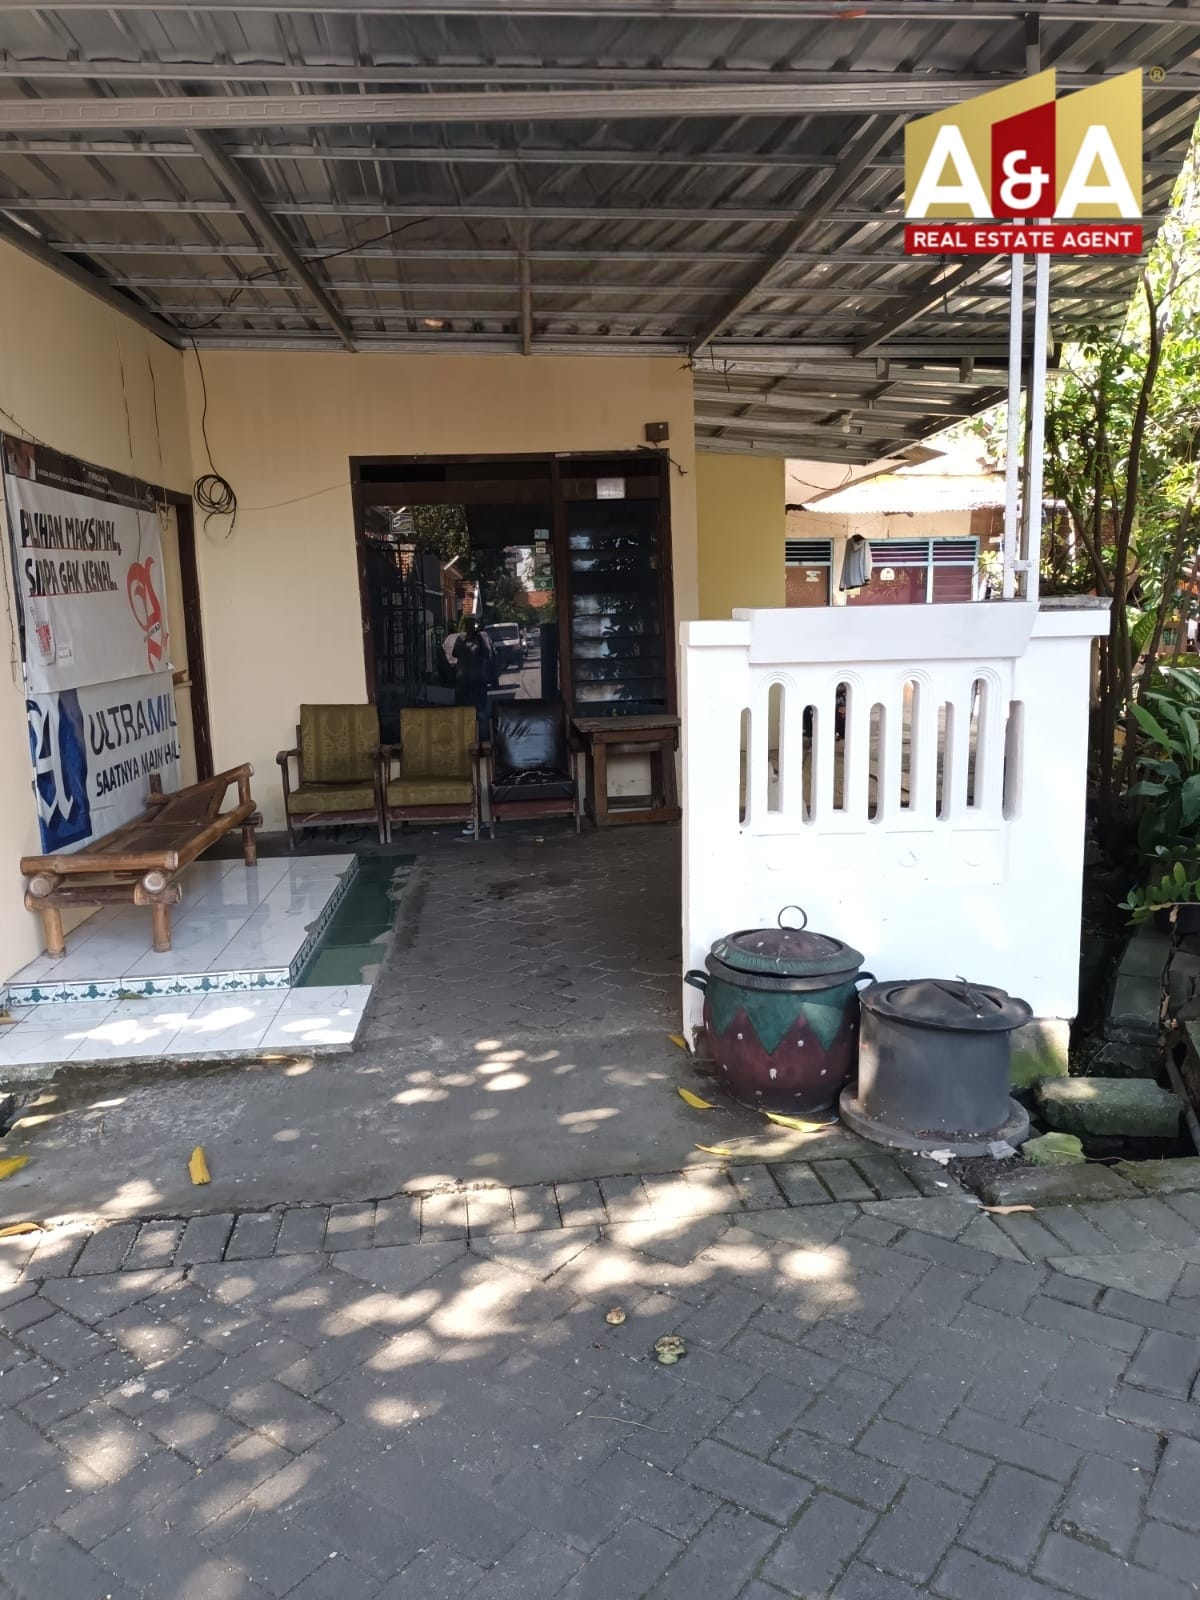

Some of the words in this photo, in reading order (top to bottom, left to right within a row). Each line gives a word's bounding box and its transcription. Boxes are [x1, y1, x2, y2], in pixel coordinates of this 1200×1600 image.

[65, 517, 122, 556] MAKSIMAL,
[59, 560, 84, 594] GAK
[96, 756, 140, 797] SAATNYA
[140, 745, 164, 775] MAIN
